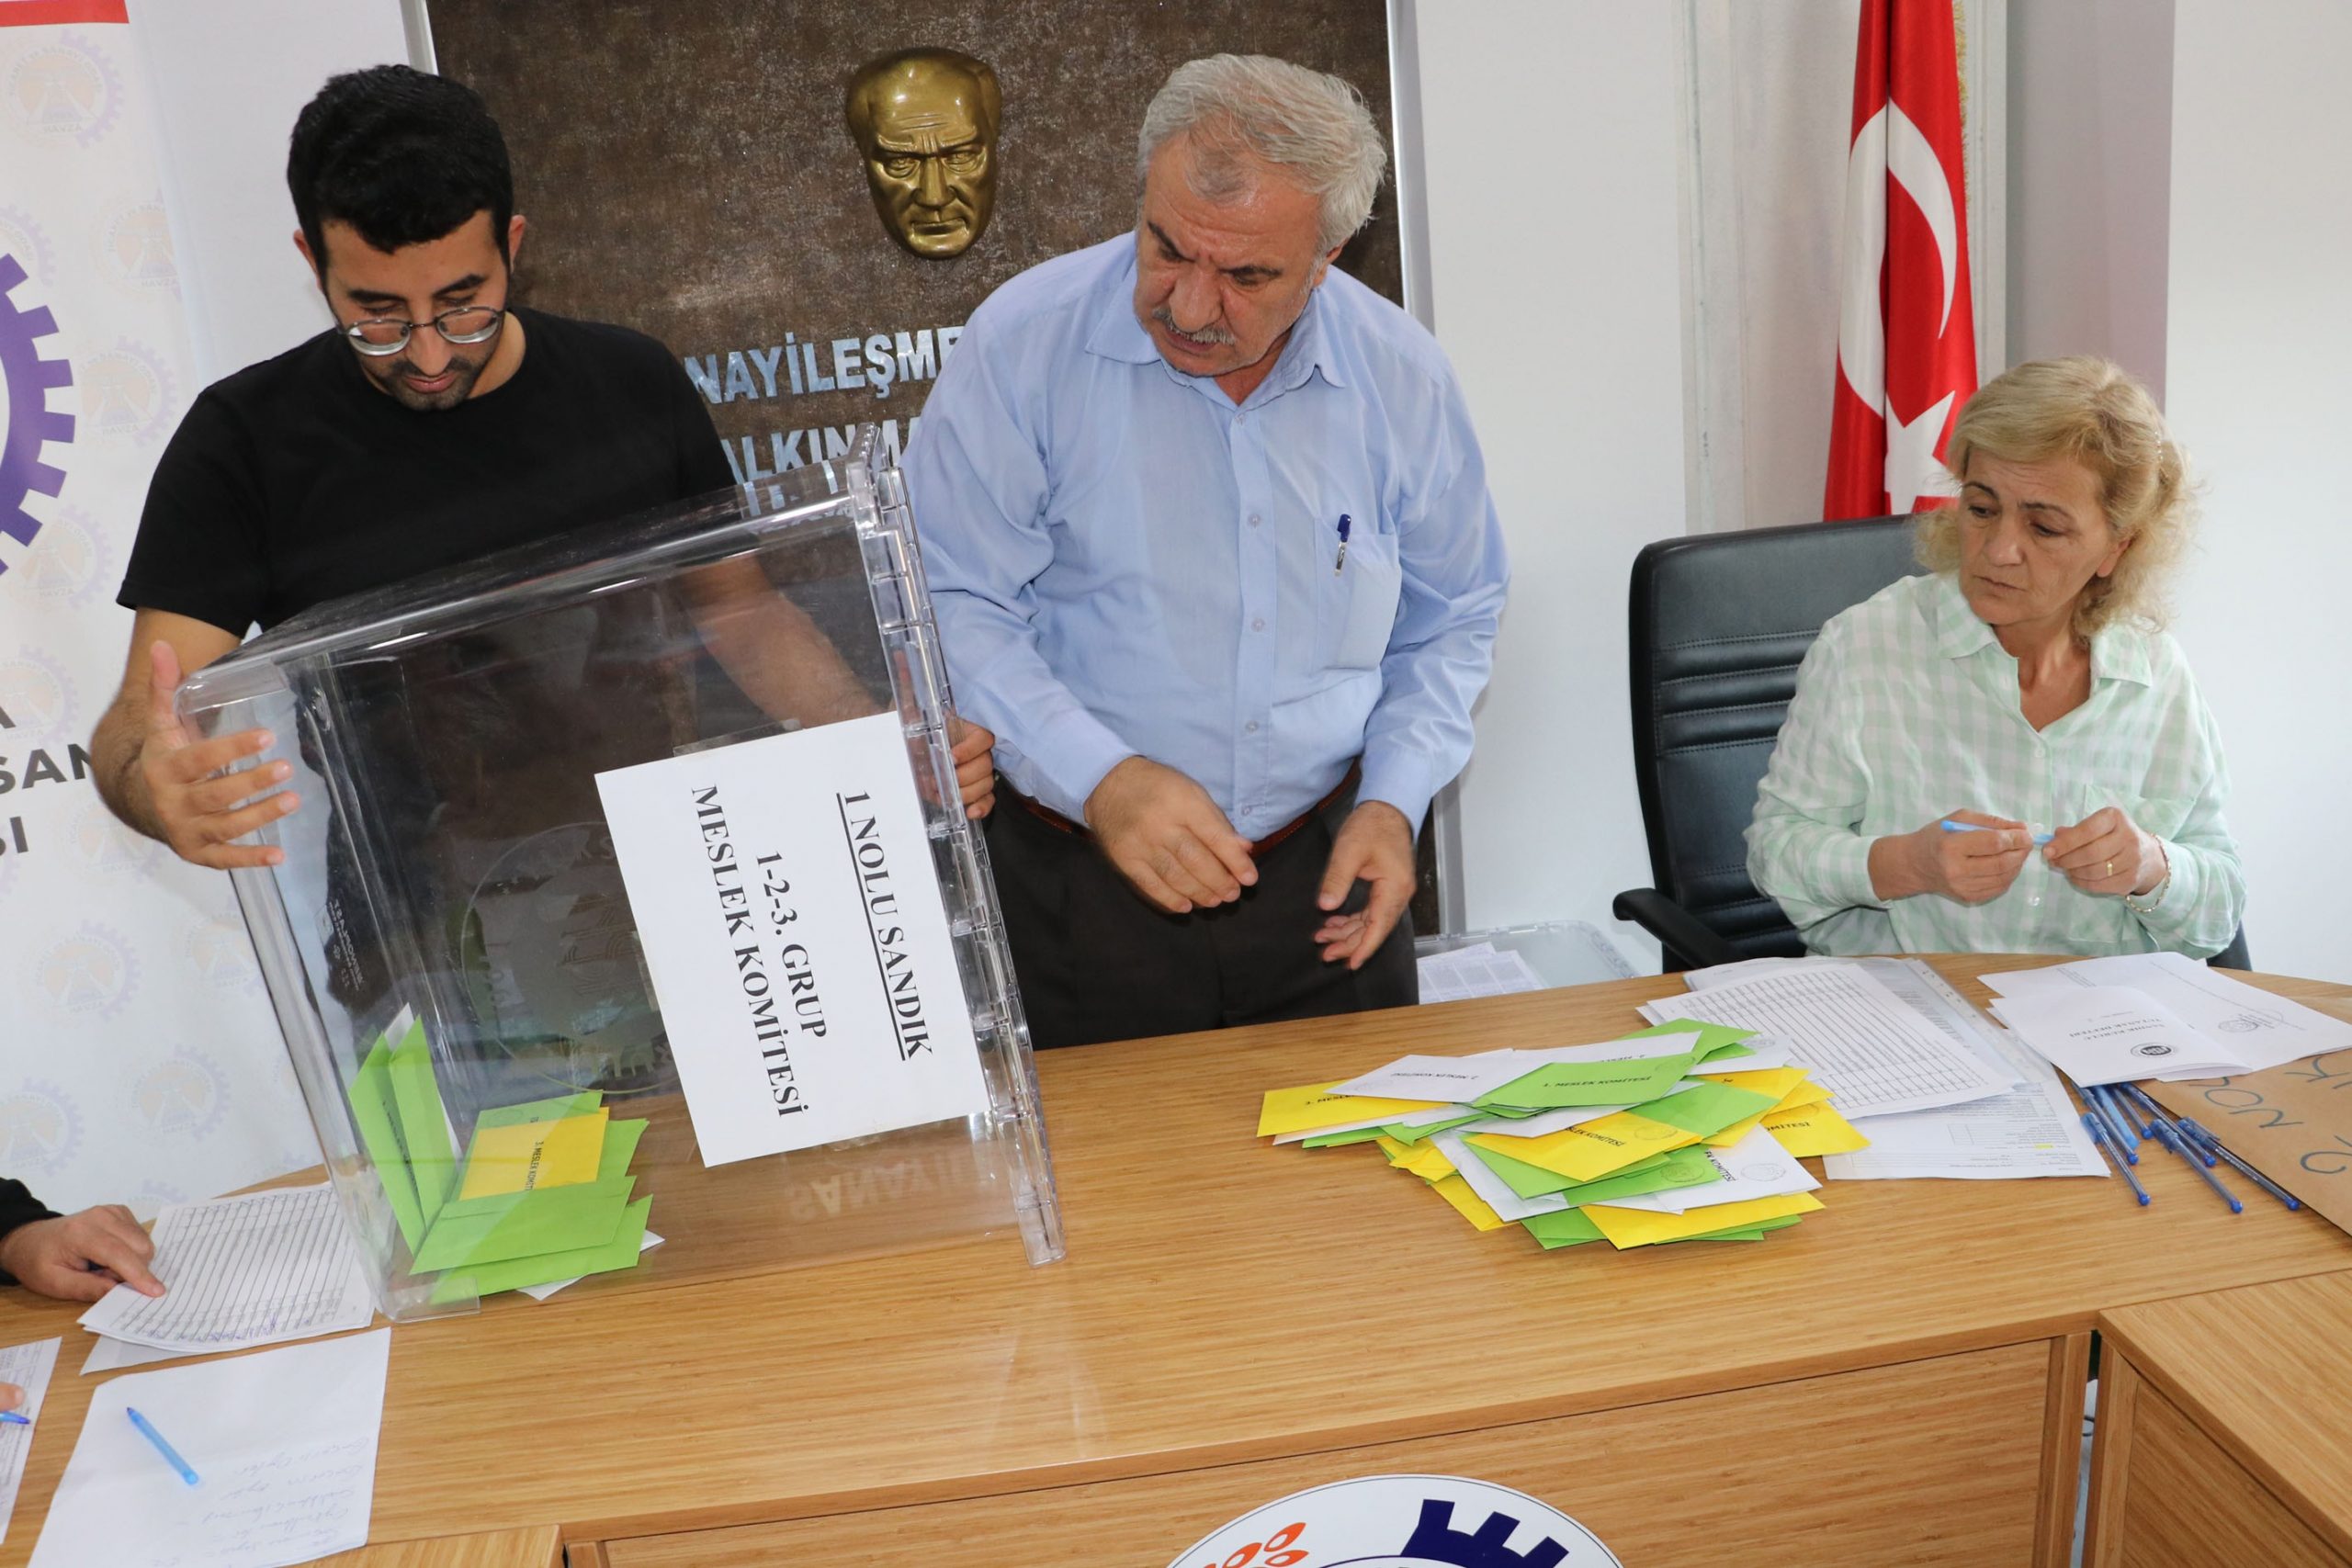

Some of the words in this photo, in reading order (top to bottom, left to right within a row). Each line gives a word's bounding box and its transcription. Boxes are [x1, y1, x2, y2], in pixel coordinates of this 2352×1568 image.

[42, 122, 83, 134] HAVZA
[844, 792, 870, 806] 1
[851, 814, 901, 918] NOLU
[691, 784, 756, 937] MESLEK
[734, 945, 809, 1117] KOMİTESİ
[756, 851, 798, 938] 1-2-3.
[781, 942, 829, 1039] GRUP
[878, 926, 933, 1058] SANDIK
[1554, 1079, 1596, 1088] MESLEK
[529, 1146, 542, 1169] MESLEK
